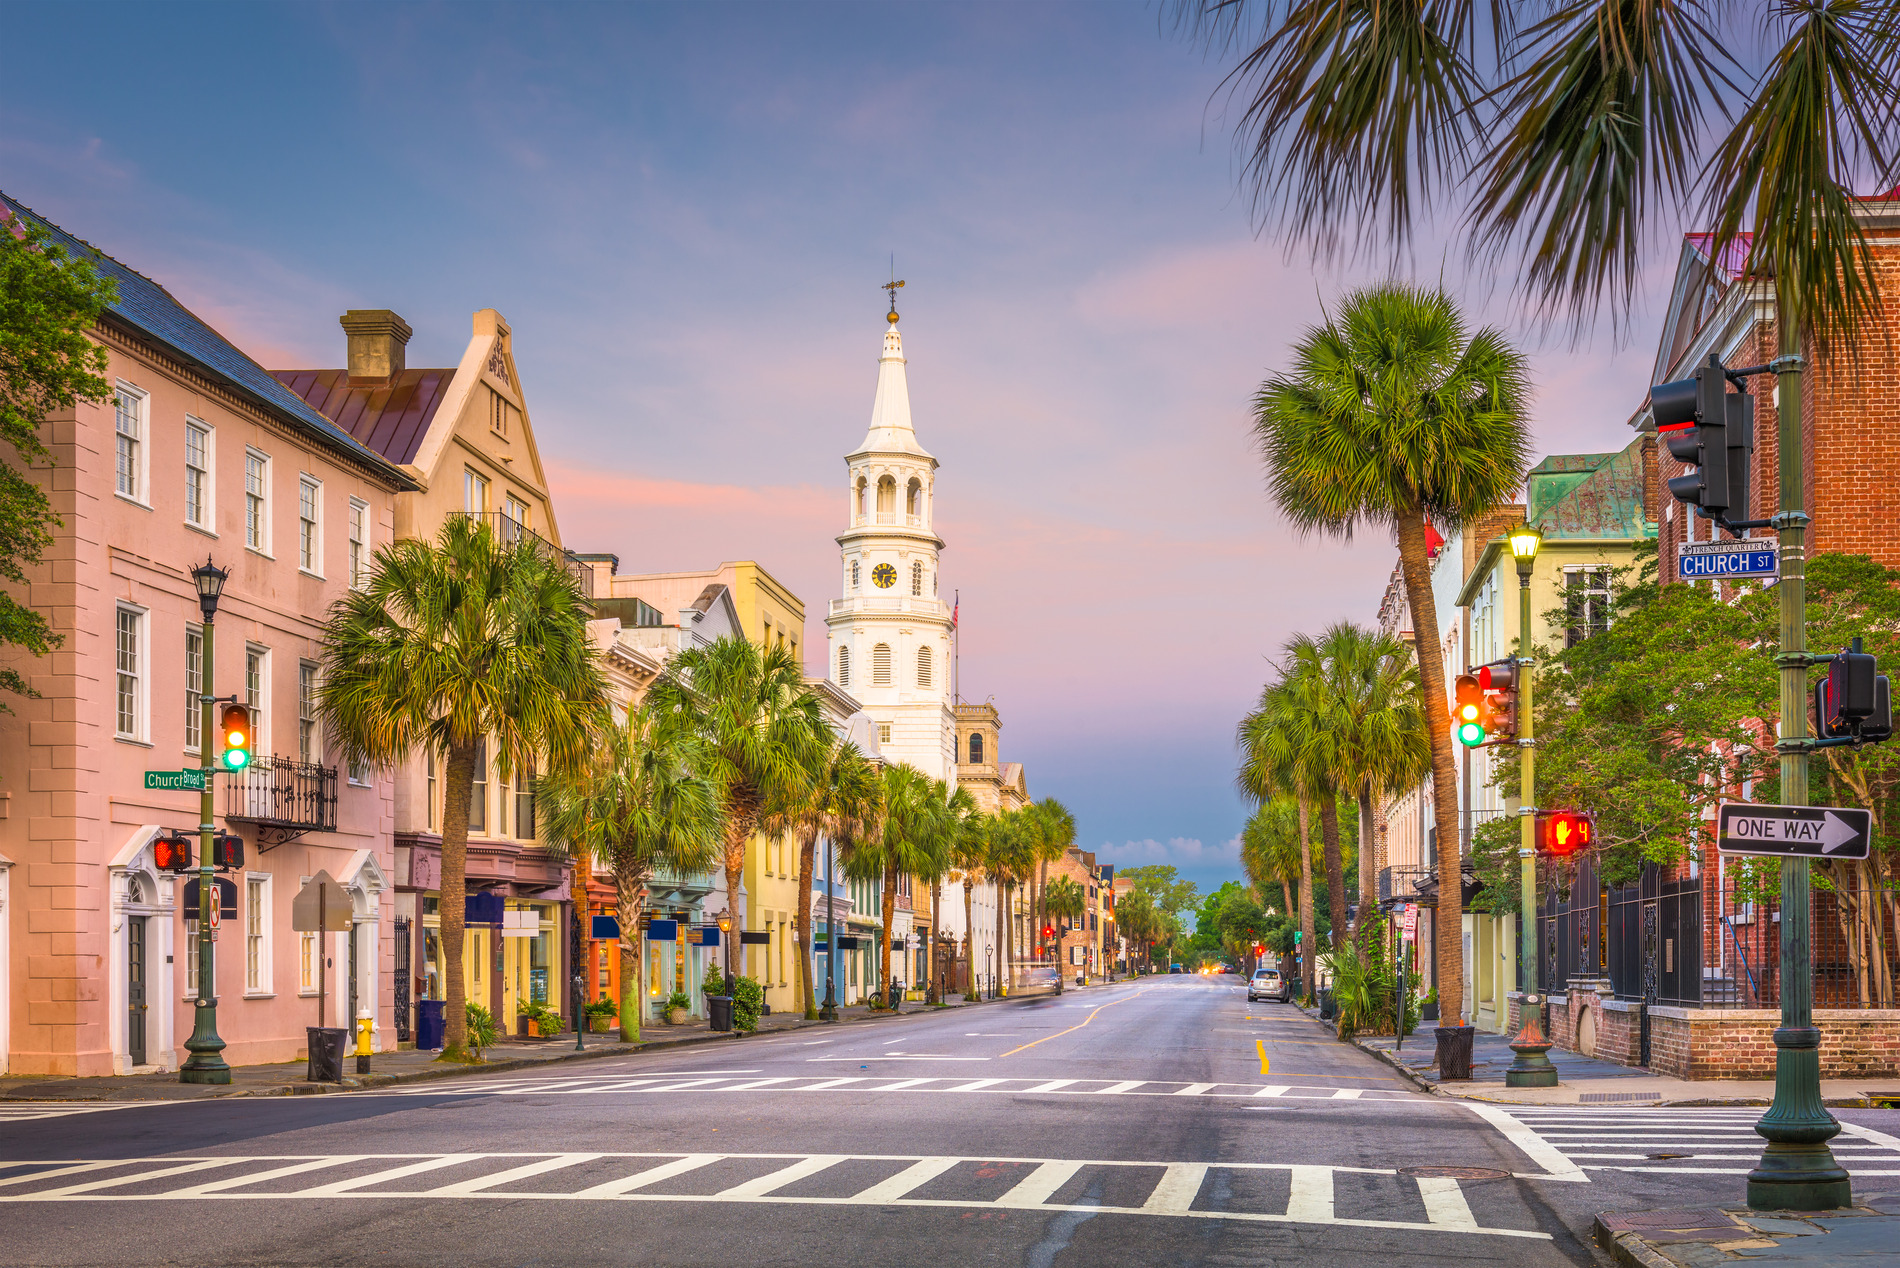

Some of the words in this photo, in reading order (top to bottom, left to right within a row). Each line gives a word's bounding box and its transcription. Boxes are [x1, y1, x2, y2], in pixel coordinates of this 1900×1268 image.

[1725, 544, 1759, 553] QUARTER
[1684, 554, 1749, 574] CHURCH
[1757, 556, 1769, 567] ST
[183, 770, 199, 785] Broad
[1579, 822, 1587, 841] 4
[1736, 818, 1775, 838] ONE
[1784, 821, 1825, 840] WAY
